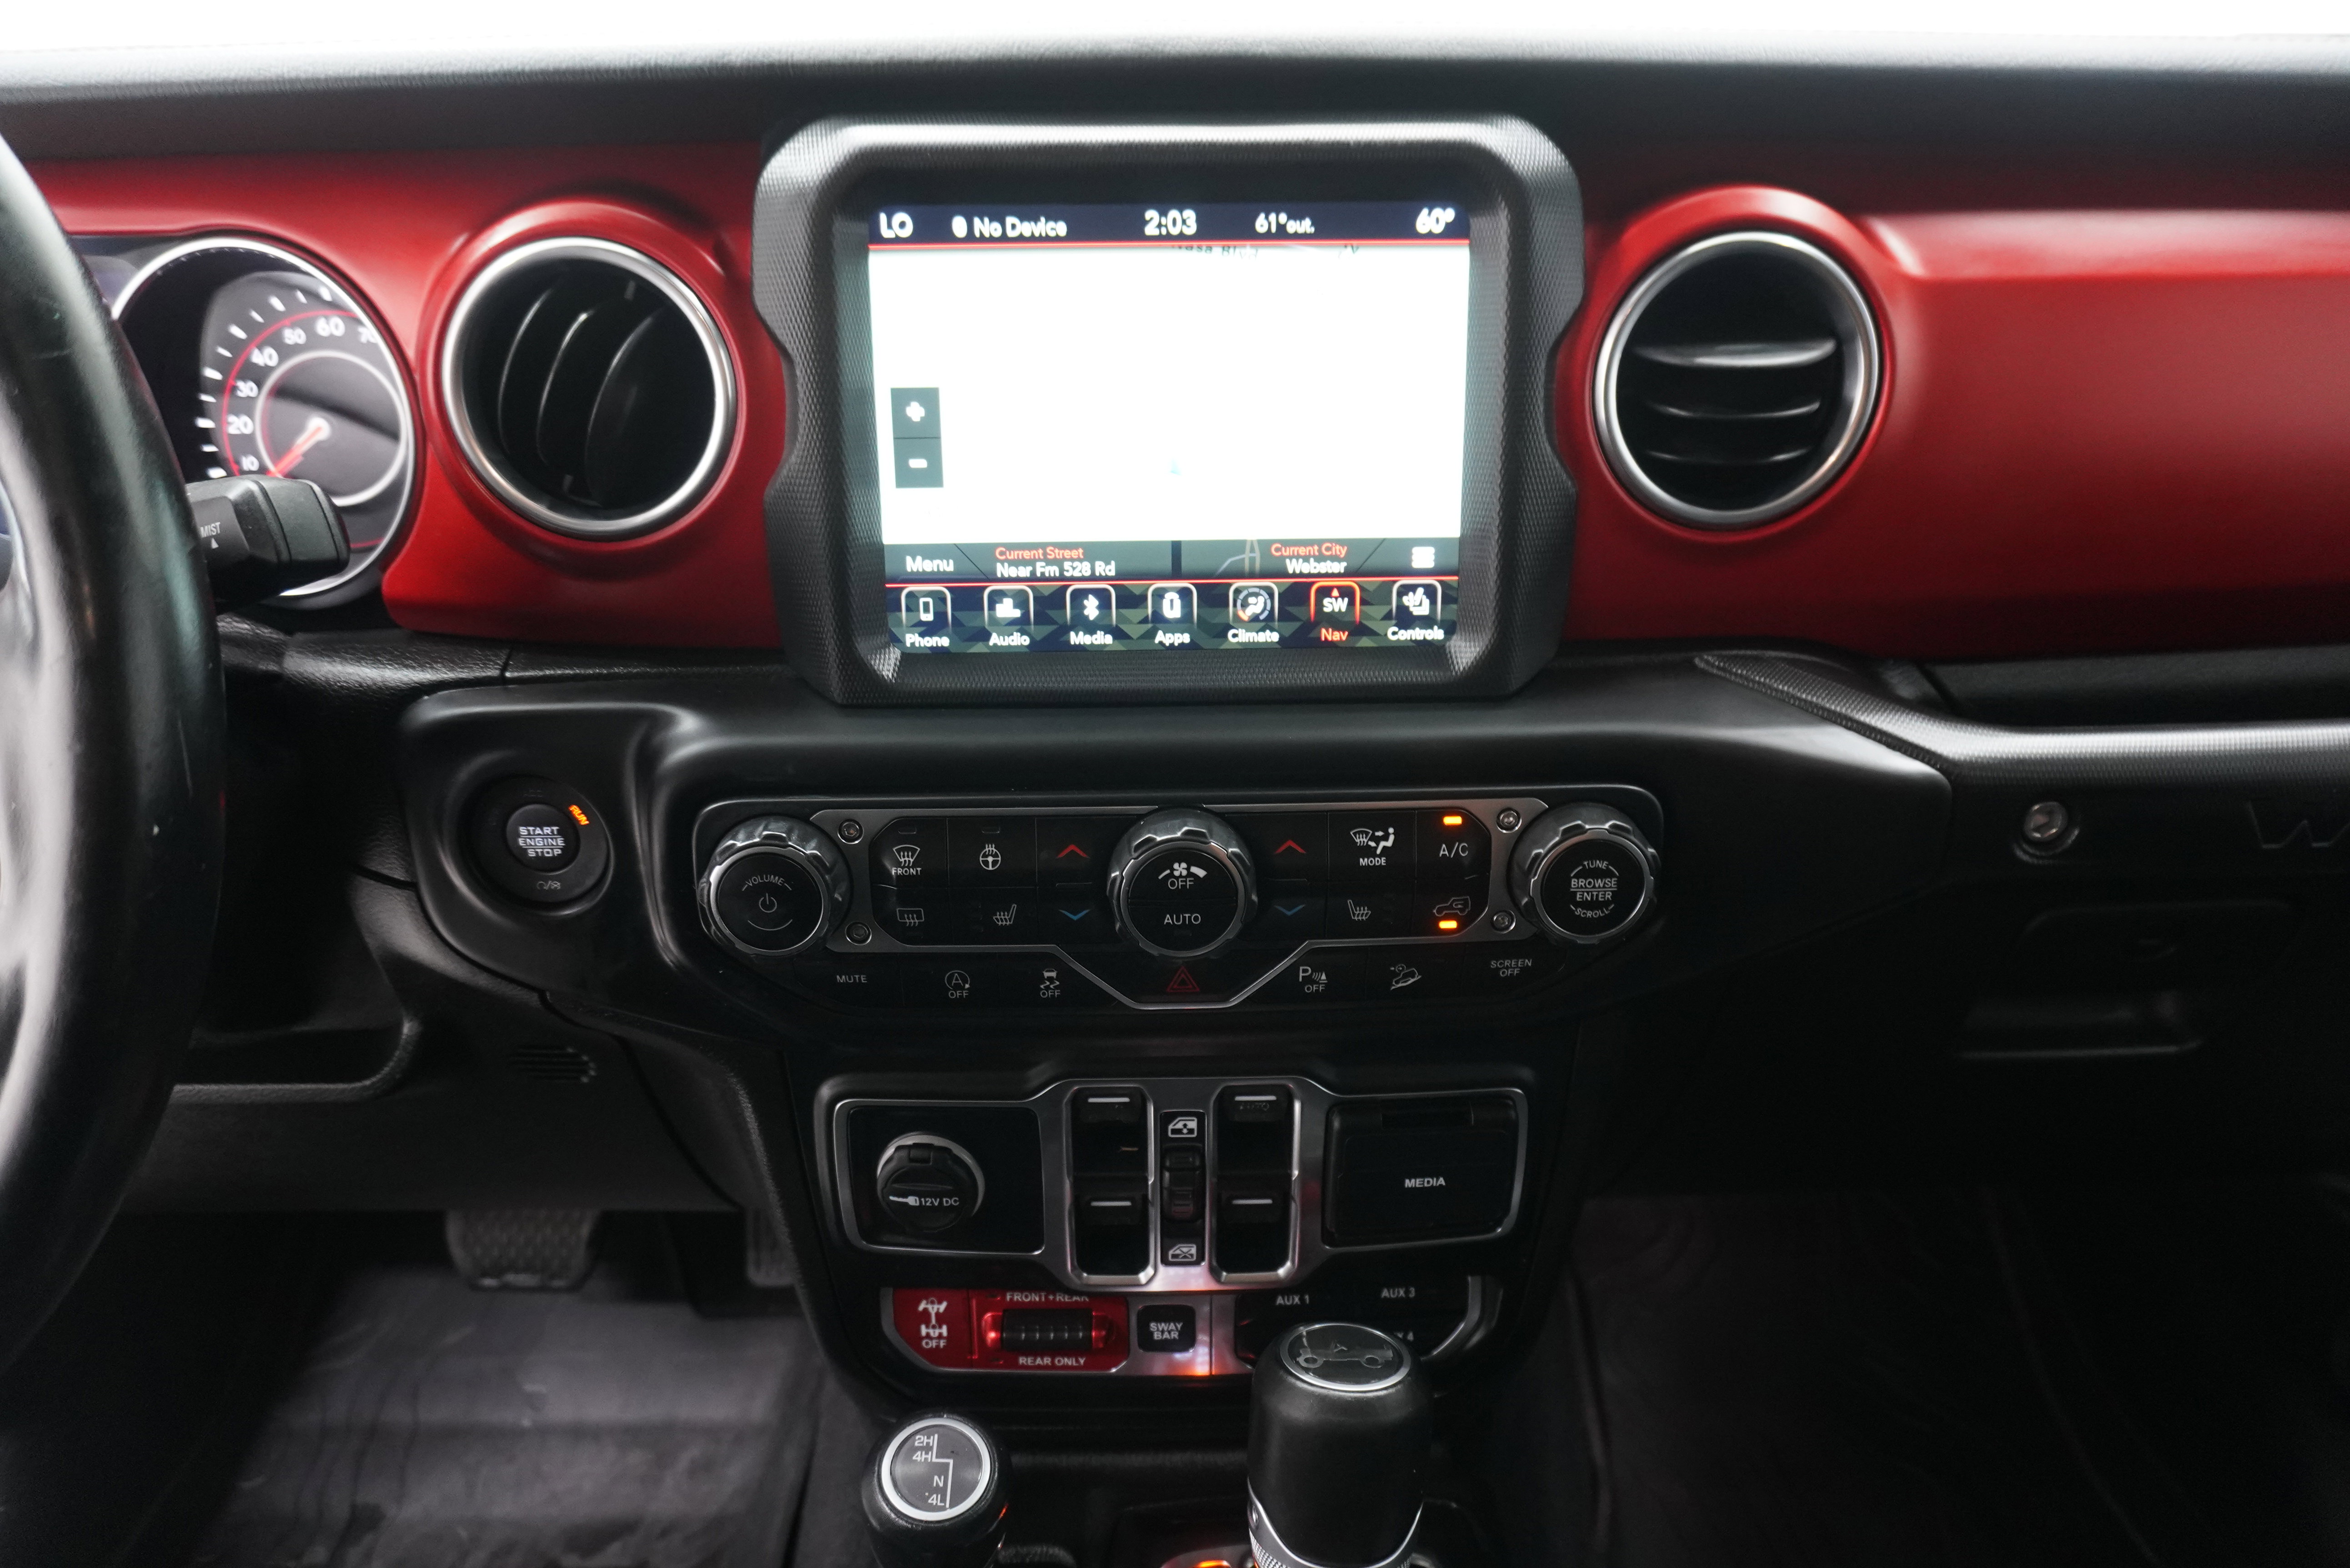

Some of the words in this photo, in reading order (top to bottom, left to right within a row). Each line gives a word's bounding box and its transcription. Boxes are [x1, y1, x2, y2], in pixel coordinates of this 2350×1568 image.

[879, 212, 913, 238] LO
[973, 216, 1002, 238] No
[1005, 216, 1067, 238] Device
[1144, 209, 1197, 236] 2:03
[315, 317, 346, 337] 60
[281, 328, 306, 345] 50
[249, 346, 279, 367] 40
[235, 381, 259, 398] 30
[226, 414, 253, 435] 20
[242, 456, 259, 471] 10
[200, 522, 221, 538] MIST
[996, 547, 1043, 559] Current
[1046, 547, 1084, 559] Street
[1271, 543, 1318, 556] Current
[1321, 543, 1347, 558] City
[906, 556, 954, 573] Menu
[996, 563, 1032, 578] Near
[1036, 563, 1059, 577] Fm
[1064, 562, 1091, 577] 528
[1095, 560, 1115, 576] Rd
[1286, 558, 1346, 574] Webster
[1323, 597, 1348, 613] SW
[989, 633, 1030, 646] Audio
[1070, 632, 1112, 645] Media
[1155, 630, 1190, 646] Apps
[1228, 628, 1279, 643] Climate
[1321, 628, 1348, 642] Nav
[1387, 627, 1444, 641] Controls
[906, 633, 949, 648] Phone
[569, 804, 590, 825] RUN
[519, 826, 559, 835] START
[518, 838, 566, 846] ENGINE
[527, 849, 562, 857] STOP
[1439, 842, 1469, 858] A/C
[1360, 857, 1386, 866] MODE
[1583, 859, 1608, 869] TUNE
[892, 867, 922, 876] FRONT
[746, 875, 784, 887] VOLUME
[1168, 878, 1194, 890] OFF
[1571, 878, 1618, 888] BROWSE
[1577, 891, 1612, 902] ENTER
[1574, 907, 1611, 918] SCROLL
[1164, 914, 1201, 925] AUTO
[1491, 959, 1532, 968] SCREEN
[1299, 966, 1311, 982] P
[1500, 969, 1521, 977] OFF
[836, 975, 868, 984] MUTE
[948, 990, 969, 999] OFF
[1040, 990, 1060, 998] OFF
[1305, 985, 1325, 993] OFF
[1405, 1176, 1446, 1188] MEDIA
[921, 1198, 939, 1206] 12V
[943, 1197, 959, 1206] DC
[1381, 1288, 1406, 1298] AUX
[1409, 1287, 1415, 1297] 3
[1276, 1295, 1301, 1306] AUX
[1305, 1294, 1310, 1304] 1
[1150, 1323, 1183, 1332] SWAY
[922, 1339, 946, 1348] OFF
[1019, 1357, 1052, 1366] REAR
[1055, 1357, 1086, 1366] ONLY
[914, 1436, 933, 1446] 2H
[912, 1451, 931, 1462] 4H
[934, 1475, 944, 1487] N
[928, 1493, 944, 1506] 4L
